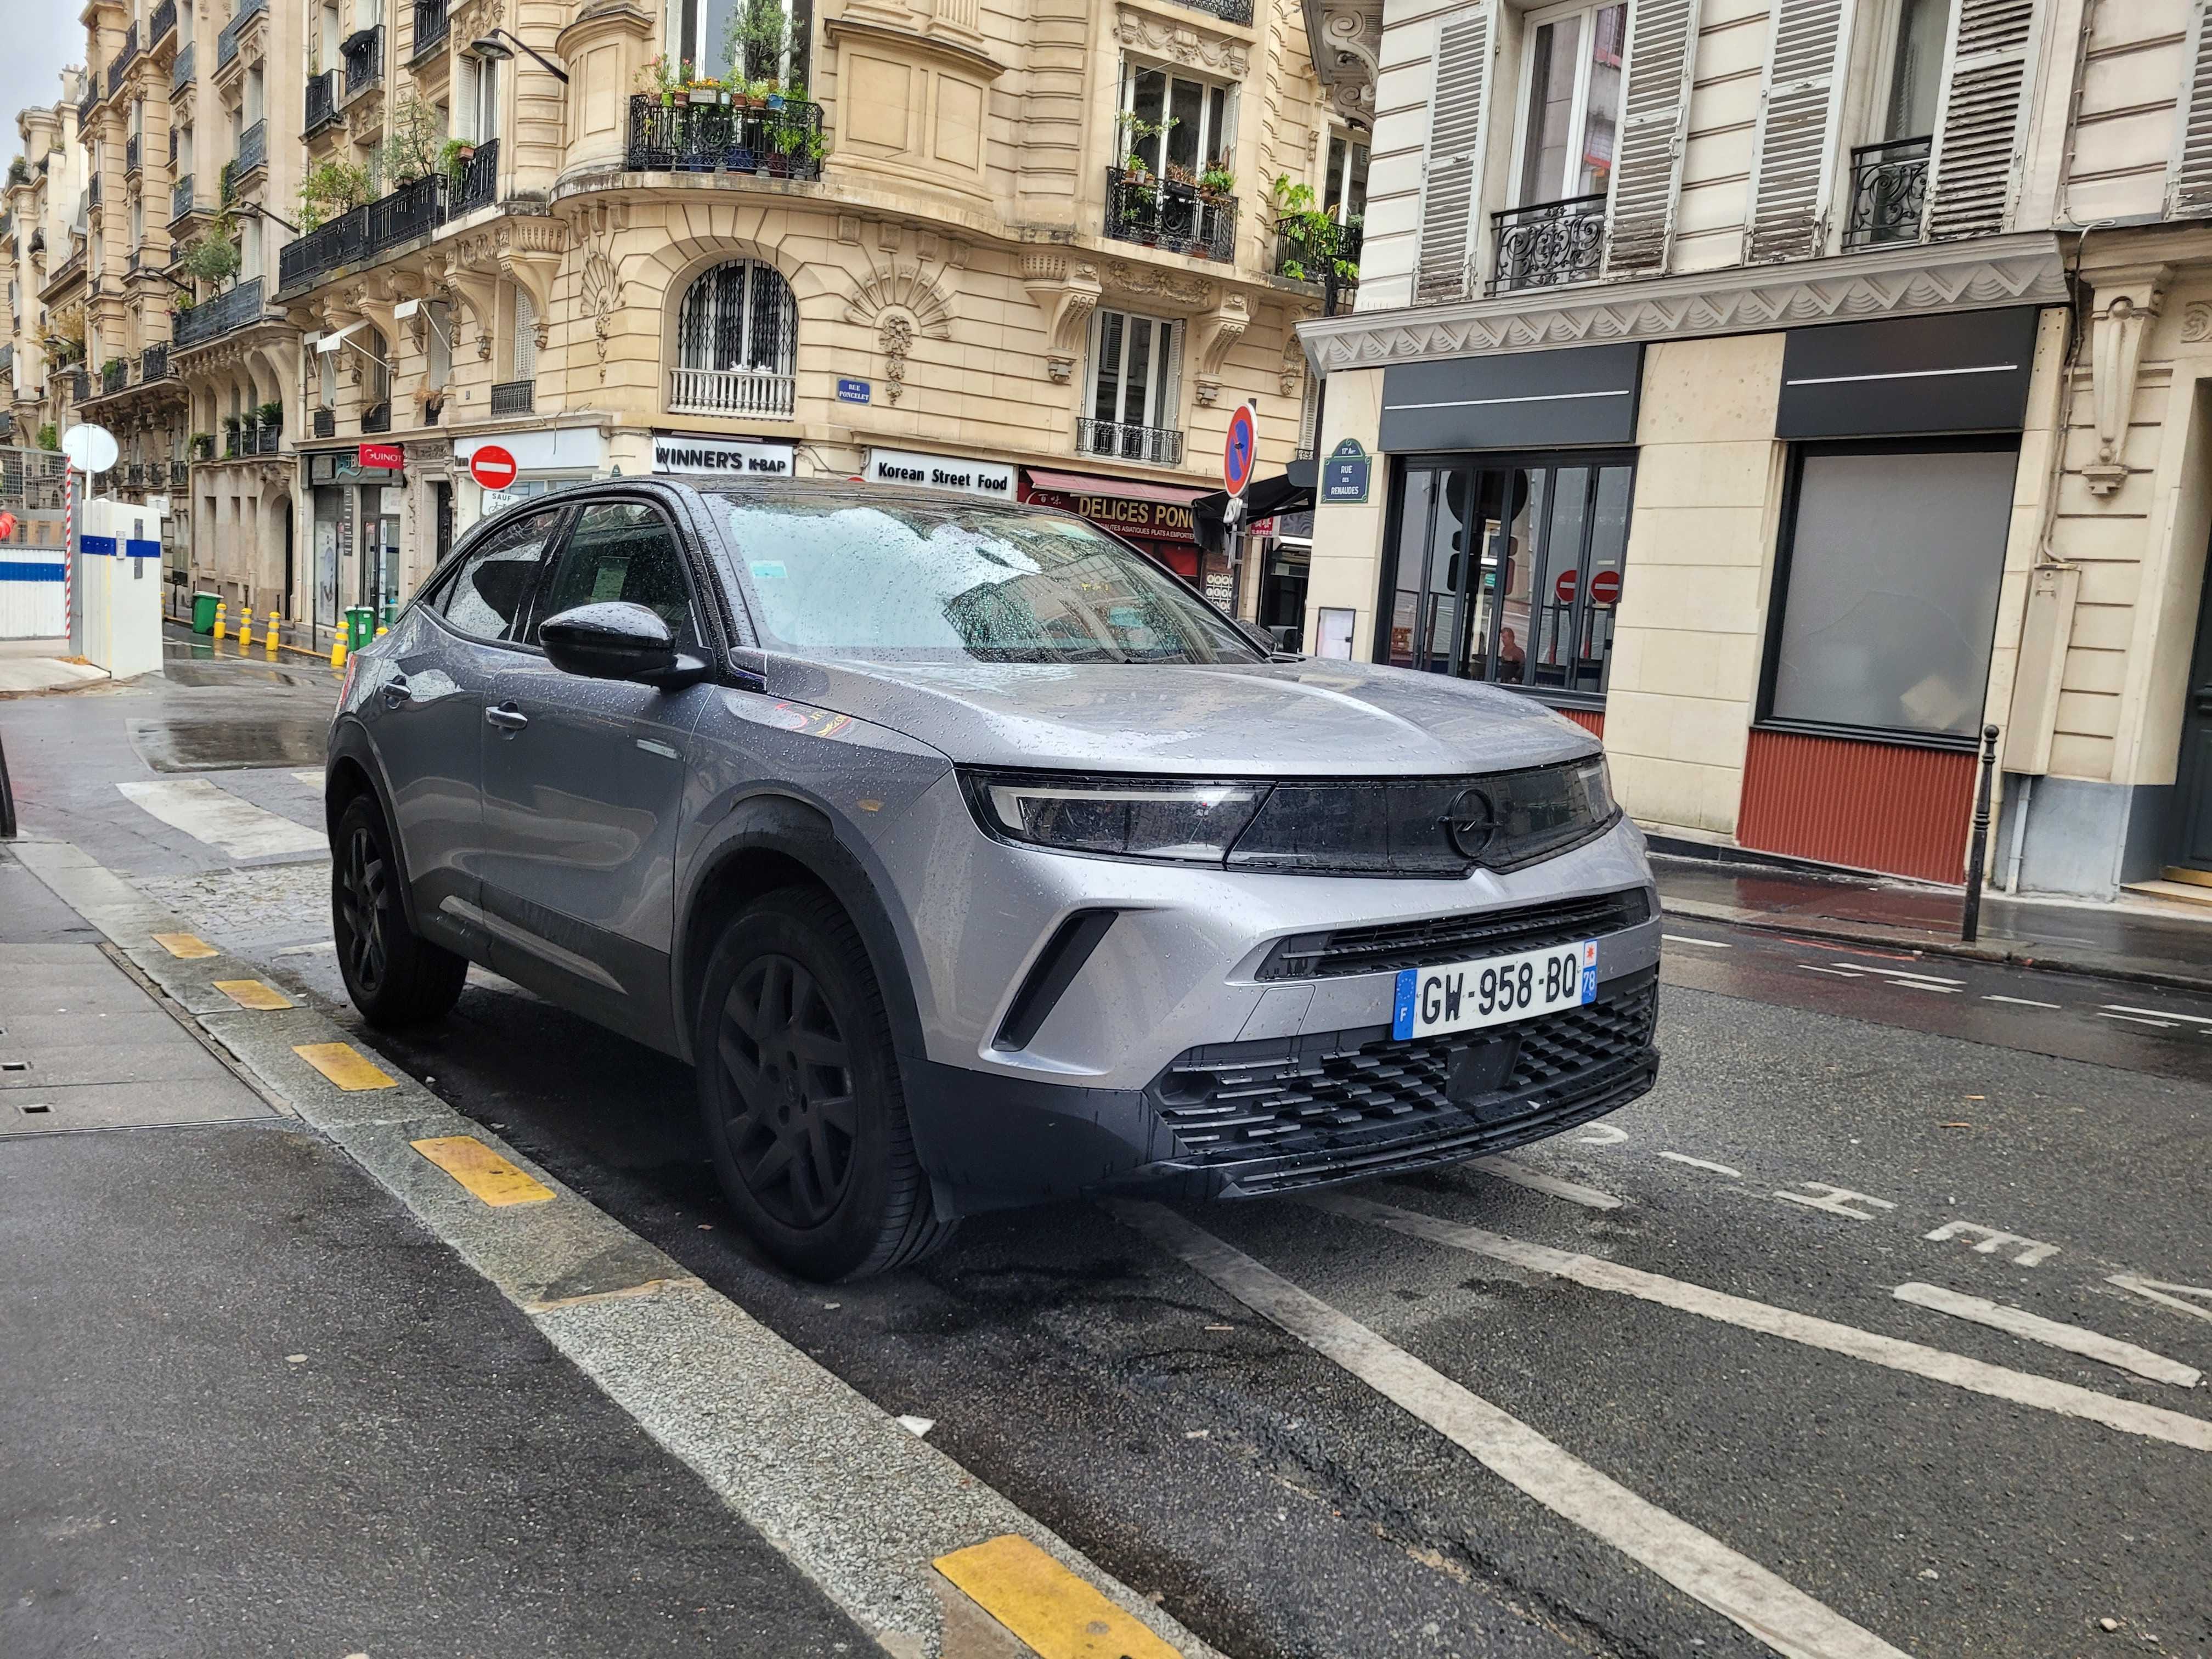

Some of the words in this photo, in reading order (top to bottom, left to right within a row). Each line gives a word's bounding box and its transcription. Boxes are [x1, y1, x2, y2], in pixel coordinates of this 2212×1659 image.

[839, 391, 870, 400] PONCELET
[656, 447, 743, 470] WINNER'S
[748, 458, 786, 472] K-BAP
[878, 462, 924, 481] Korean
[932, 469, 970, 486] Street
[978, 474, 1008, 490] Food
[1340, 465, 1353, 473] RUE
[492, 493, 512, 502] SAUF
[1330, 486, 1359, 495] RENAUDES
[1079, 496, 1149, 524] DELICES
[1121, 525, 1150, 535] ASIATIQUES
[1421, 953, 1577, 1025] GW-958-BQ
[1583, 970, 1596, 993] 78
[1400, 1007, 1408, 1023] F
